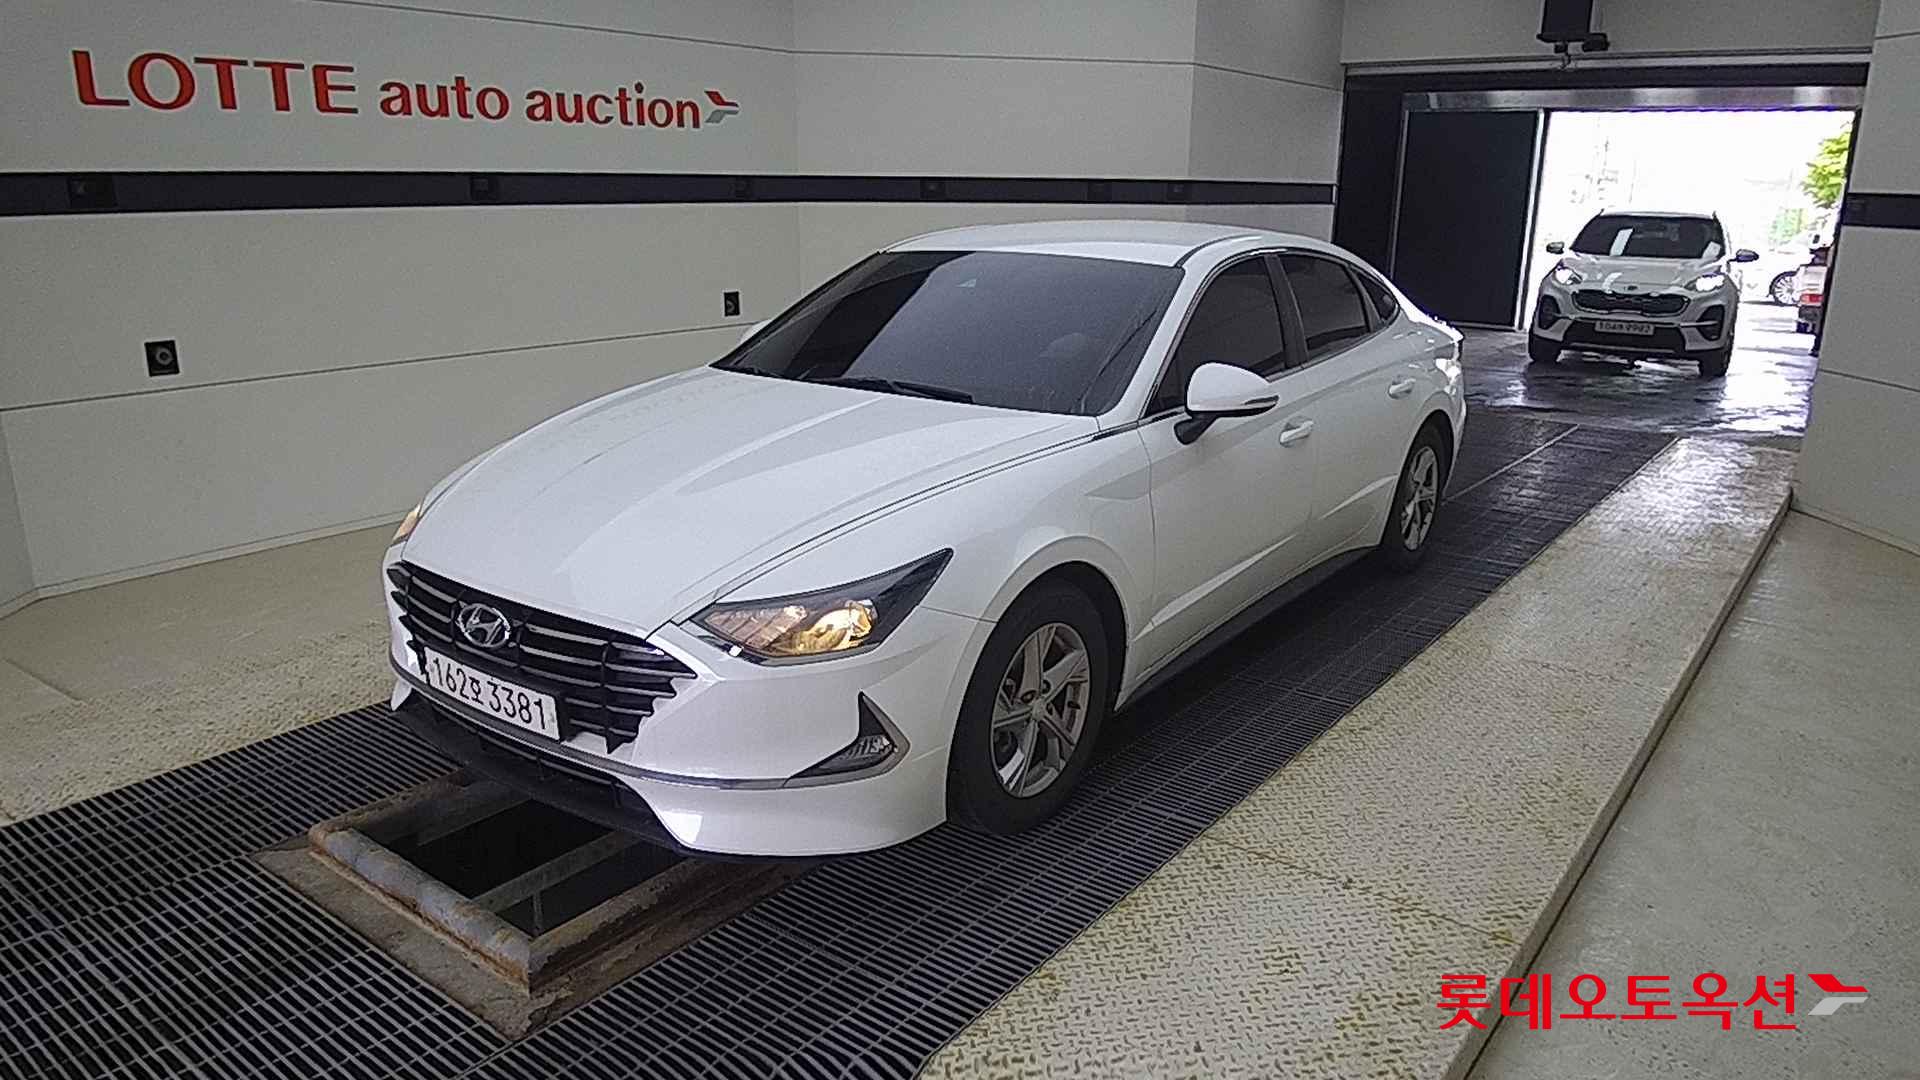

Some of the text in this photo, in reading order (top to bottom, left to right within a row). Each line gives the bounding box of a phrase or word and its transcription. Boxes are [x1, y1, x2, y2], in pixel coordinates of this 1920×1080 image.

[71, 49, 702, 129] LOTTE auto auction
[487, 680, 546, 730] 3381
